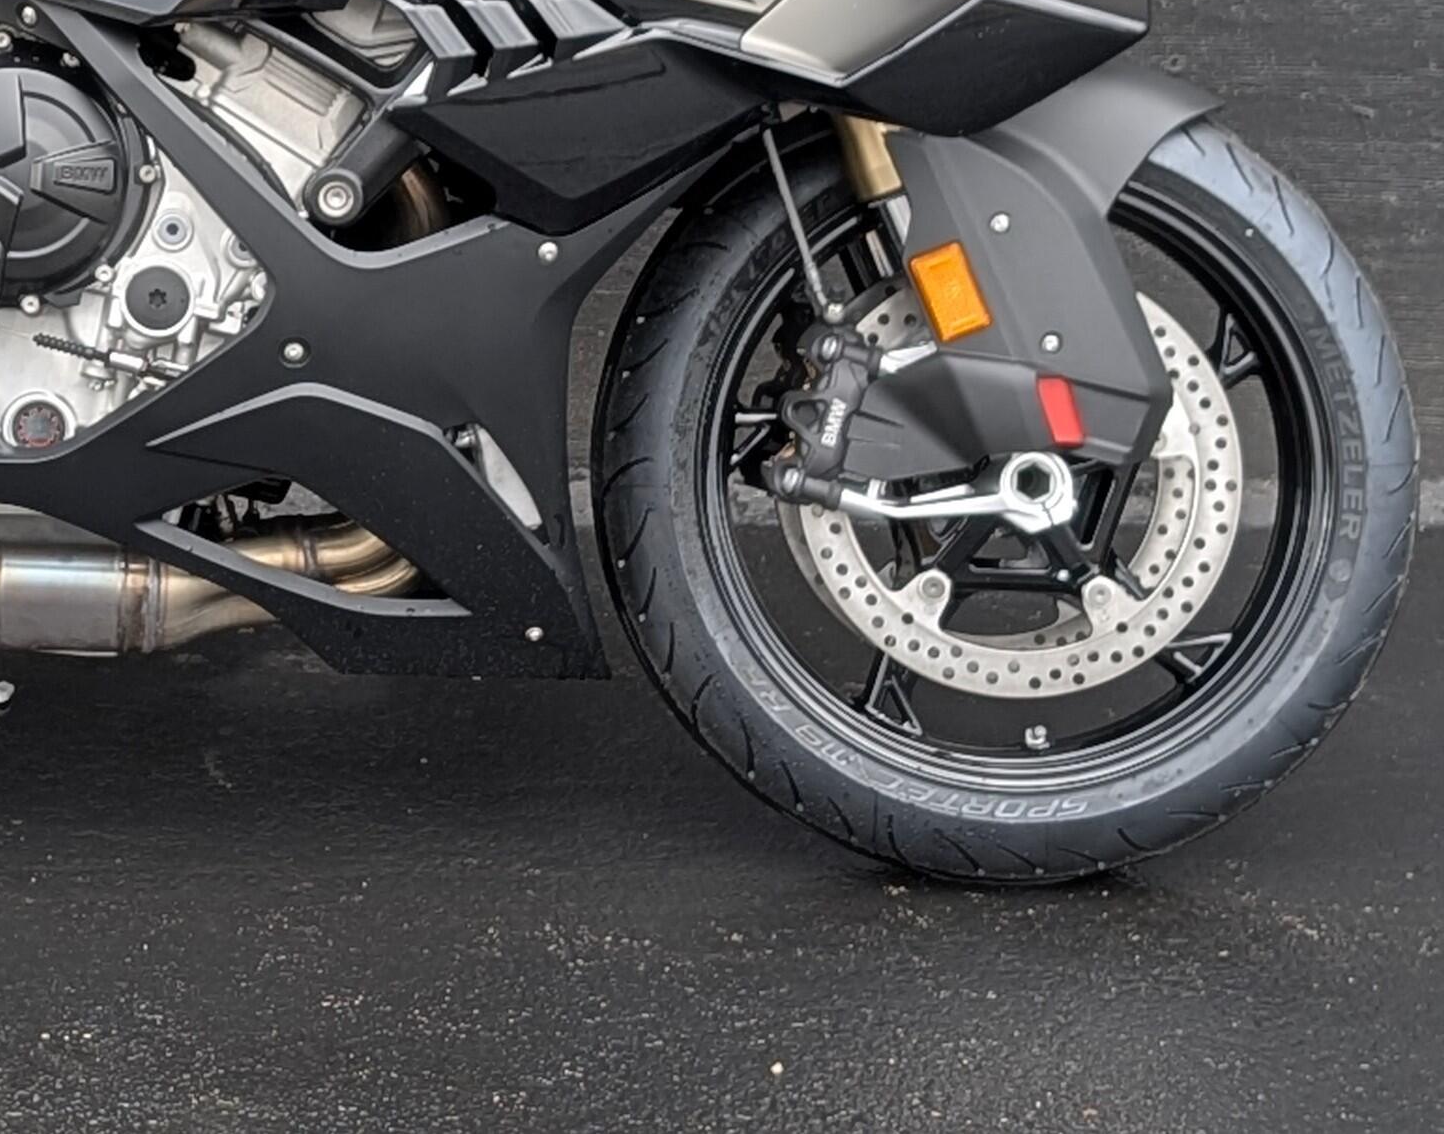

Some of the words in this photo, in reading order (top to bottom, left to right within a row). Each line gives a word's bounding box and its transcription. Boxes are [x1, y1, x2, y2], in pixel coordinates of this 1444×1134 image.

[821, 397, 847, 447] BMW
[1308, 326, 1366, 543] METZELER
[864, 764, 1090, 821] SPORTEC
